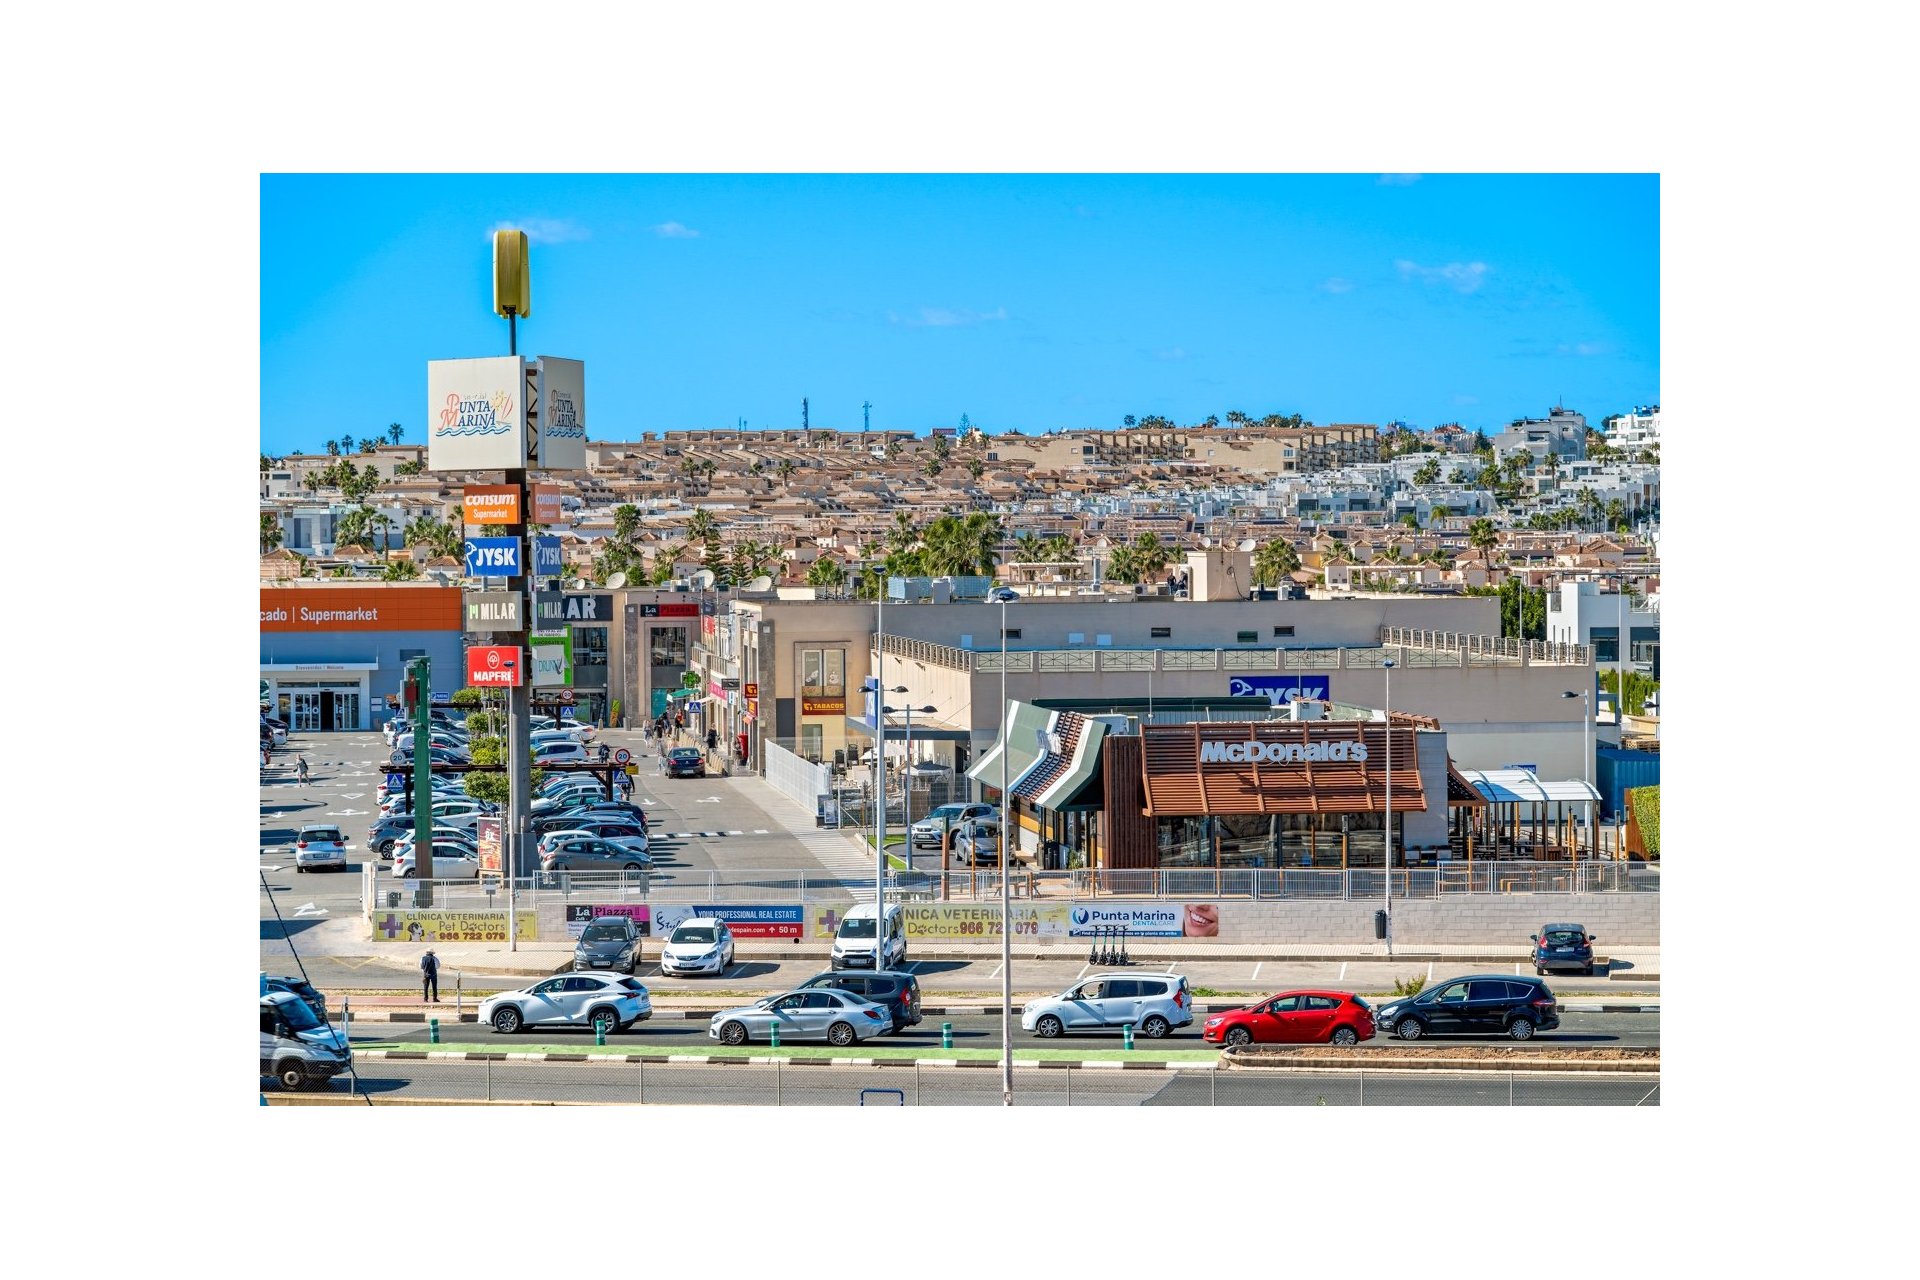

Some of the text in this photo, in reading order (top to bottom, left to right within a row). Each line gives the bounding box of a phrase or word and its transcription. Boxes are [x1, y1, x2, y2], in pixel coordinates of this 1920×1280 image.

[447, 393, 490, 414] PUNTA
[551, 390, 573, 414] PUNTA
[438, 409, 496, 430] MARINA
[548, 405, 576, 431] MARINA
[466, 494, 515, 506] consum
[473, 508, 508, 520] Supermarket
[475, 547, 516, 567] JYSK
[541, 547, 561, 566] JYSK
[300, 607, 378, 625] Supermarket
[480, 602, 516, 620] MILAR
[1200, 740, 1369, 762] McDonald's
[406, 911, 505, 921] CLÍNICA VETERINARIA
[575, 907, 591, 917] La
[595, 906, 633, 916] Plazza
[698, 910, 797, 919] YOUR PROFESSIONAL REAL ESTATE
[905, 908, 939, 920] NICA
[1092, 910, 1176, 921] Punta Marina
[439, 921, 456, 931] Pet
[778, 926, 789, 934] 50
[1015, 922, 1039, 935] 079
